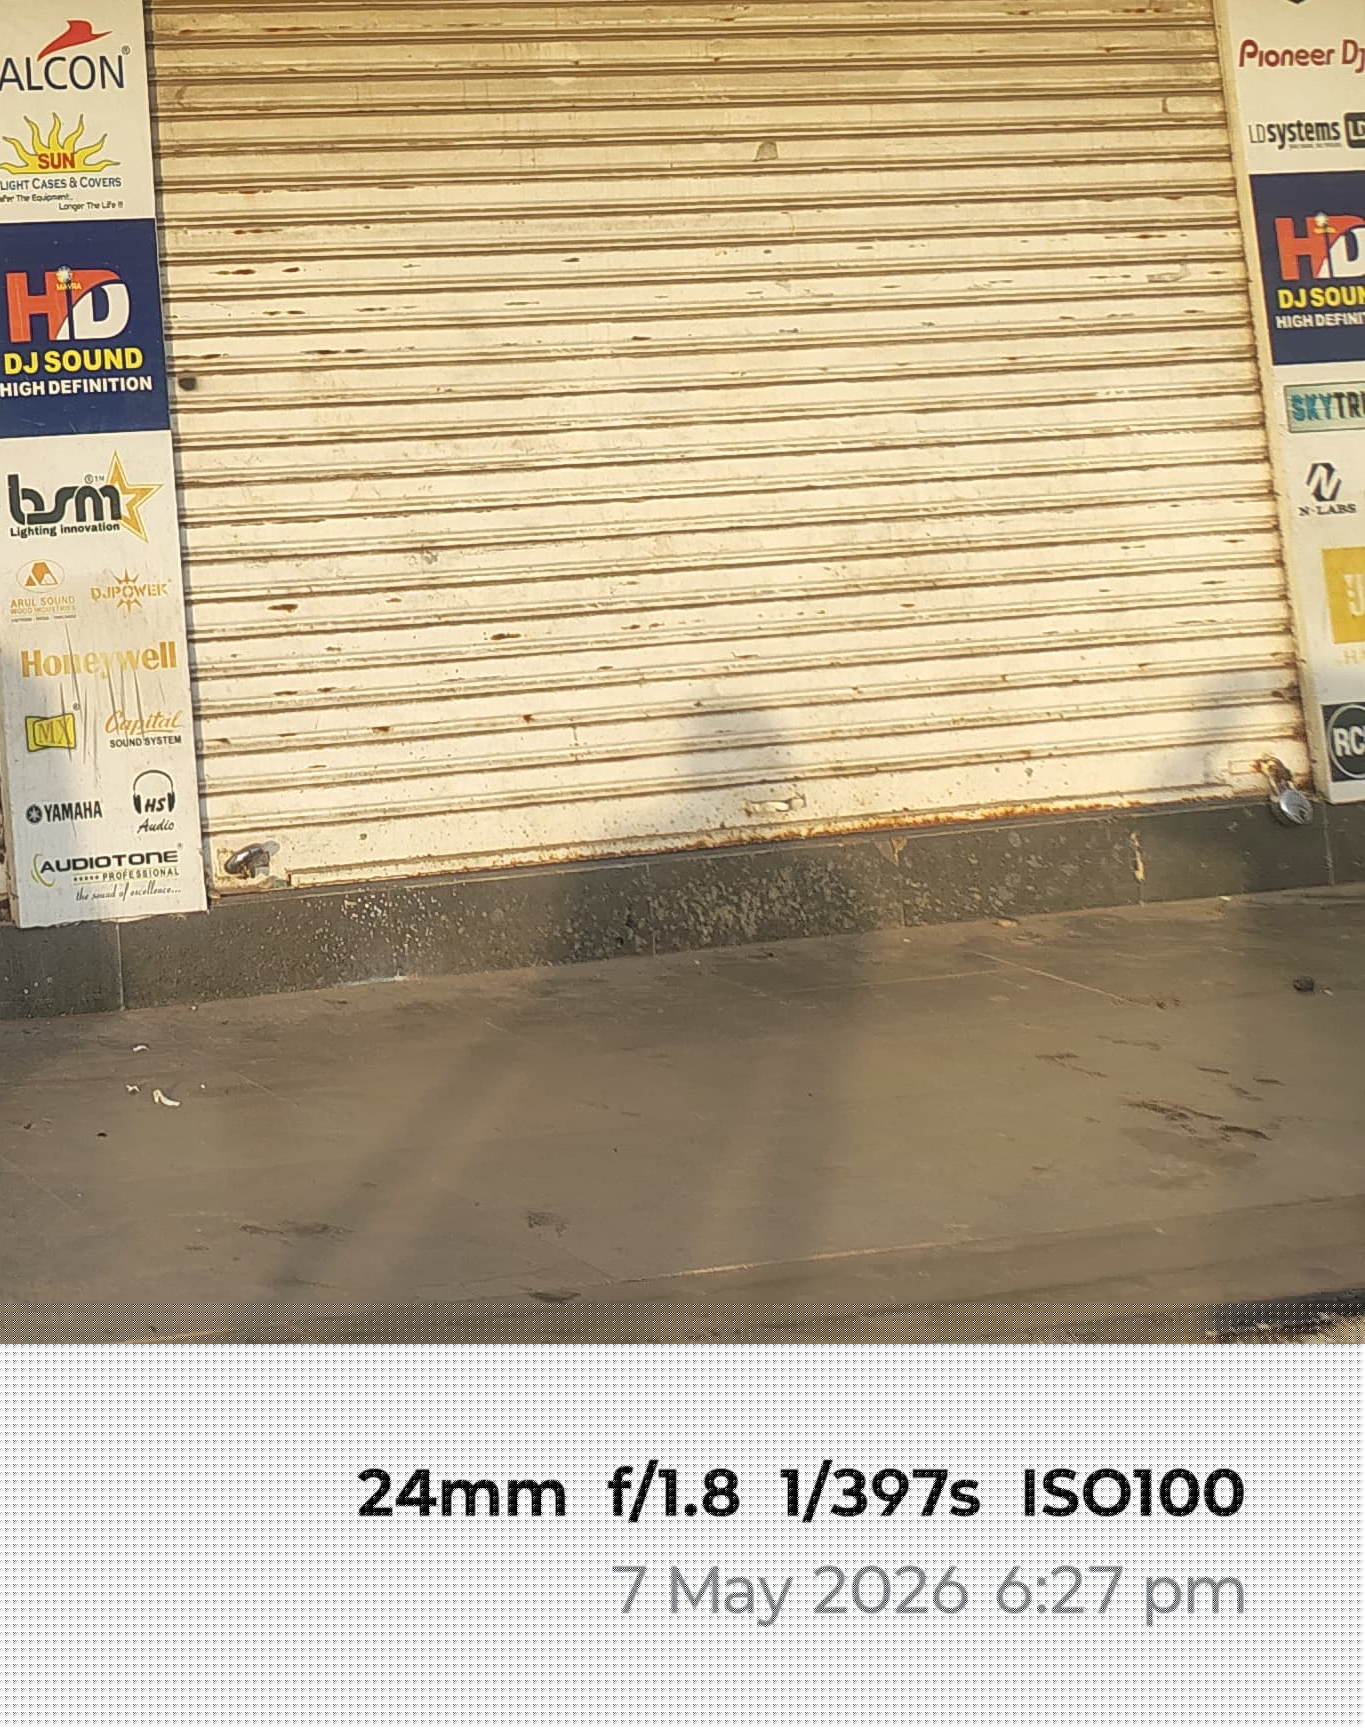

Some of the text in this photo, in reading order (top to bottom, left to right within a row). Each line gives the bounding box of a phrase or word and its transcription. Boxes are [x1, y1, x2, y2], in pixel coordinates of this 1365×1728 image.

[1240, 39, 1335, 67] Pioneer
[38, 153, 75, 169] SUN
[6, 269, 130, 343] HD
[1277, 288, 1307, 308] DJ
[1275, 312, 1365, 328] HIGH DEFINI
[4, 348, 143, 374] DJ SOUND
[0, 377, 153, 397] HIGH DEFINITION
[1291, 391, 1365, 421] SKYTR
[10, 526, 56, 538] Lighting
[11, 596, 75, 608] ARUL SOUND
[21, 641, 177, 679] Honeywell
[110, 736, 181, 748] SOUND SYSTEM
[44, 801, 102, 822] YAMAHA
[145, 798, 166, 812] HS
[137, 818, 174, 834] Audio
[103, 868, 179, 881] PROFESSIONAL
